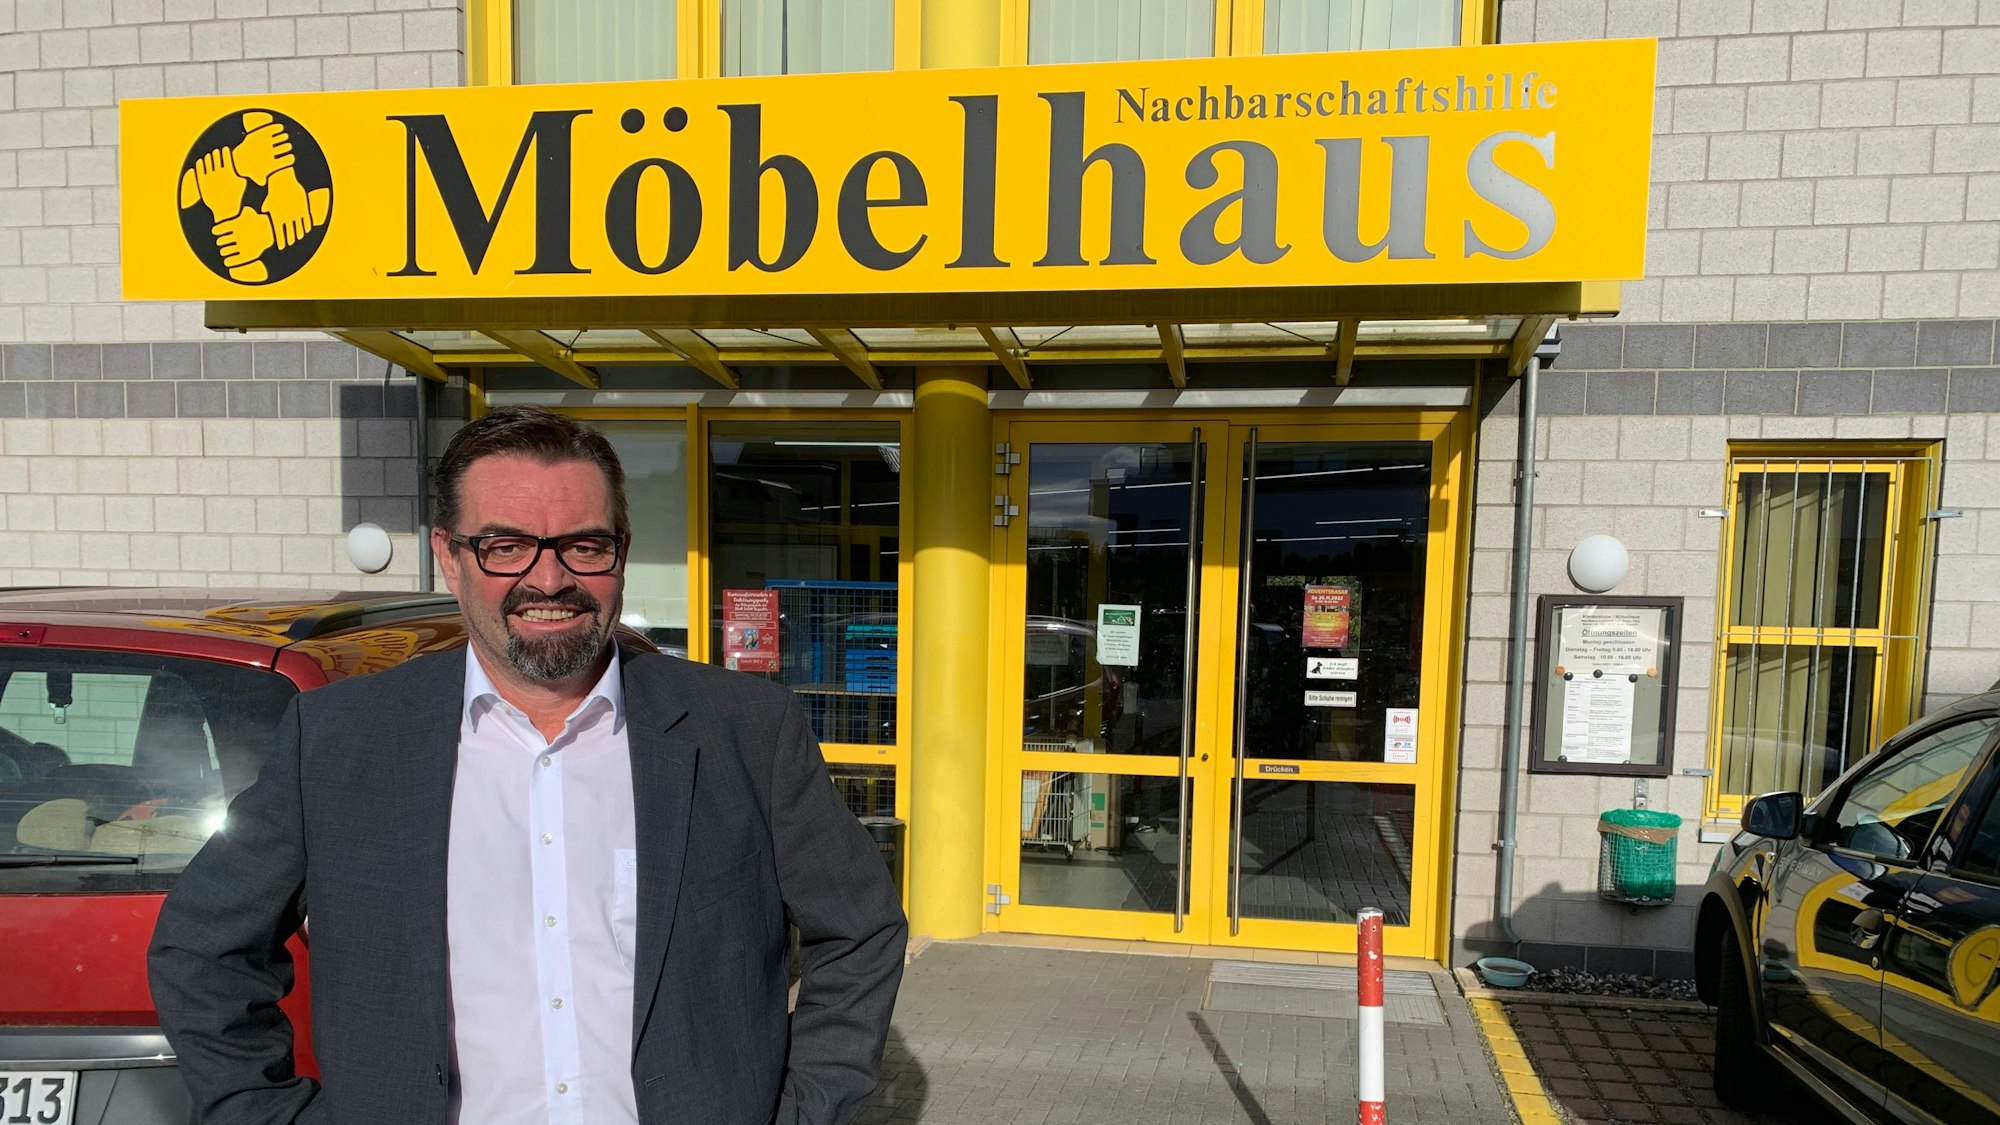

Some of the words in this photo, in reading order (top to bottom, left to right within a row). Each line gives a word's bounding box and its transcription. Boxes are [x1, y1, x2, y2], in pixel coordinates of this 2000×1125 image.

[1114, 71, 1558, 125] Nachbarschaftshilfe
[385, 91, 1558, 278] Möbelhaus
[1581, 629, 1638, 638] Öffnungszeiten
[1335, 695, 1353, 703] reinigen
[1265, 765, 1294, 773] Drücken
[1778, 856, 1824, 879] STEPWAY
